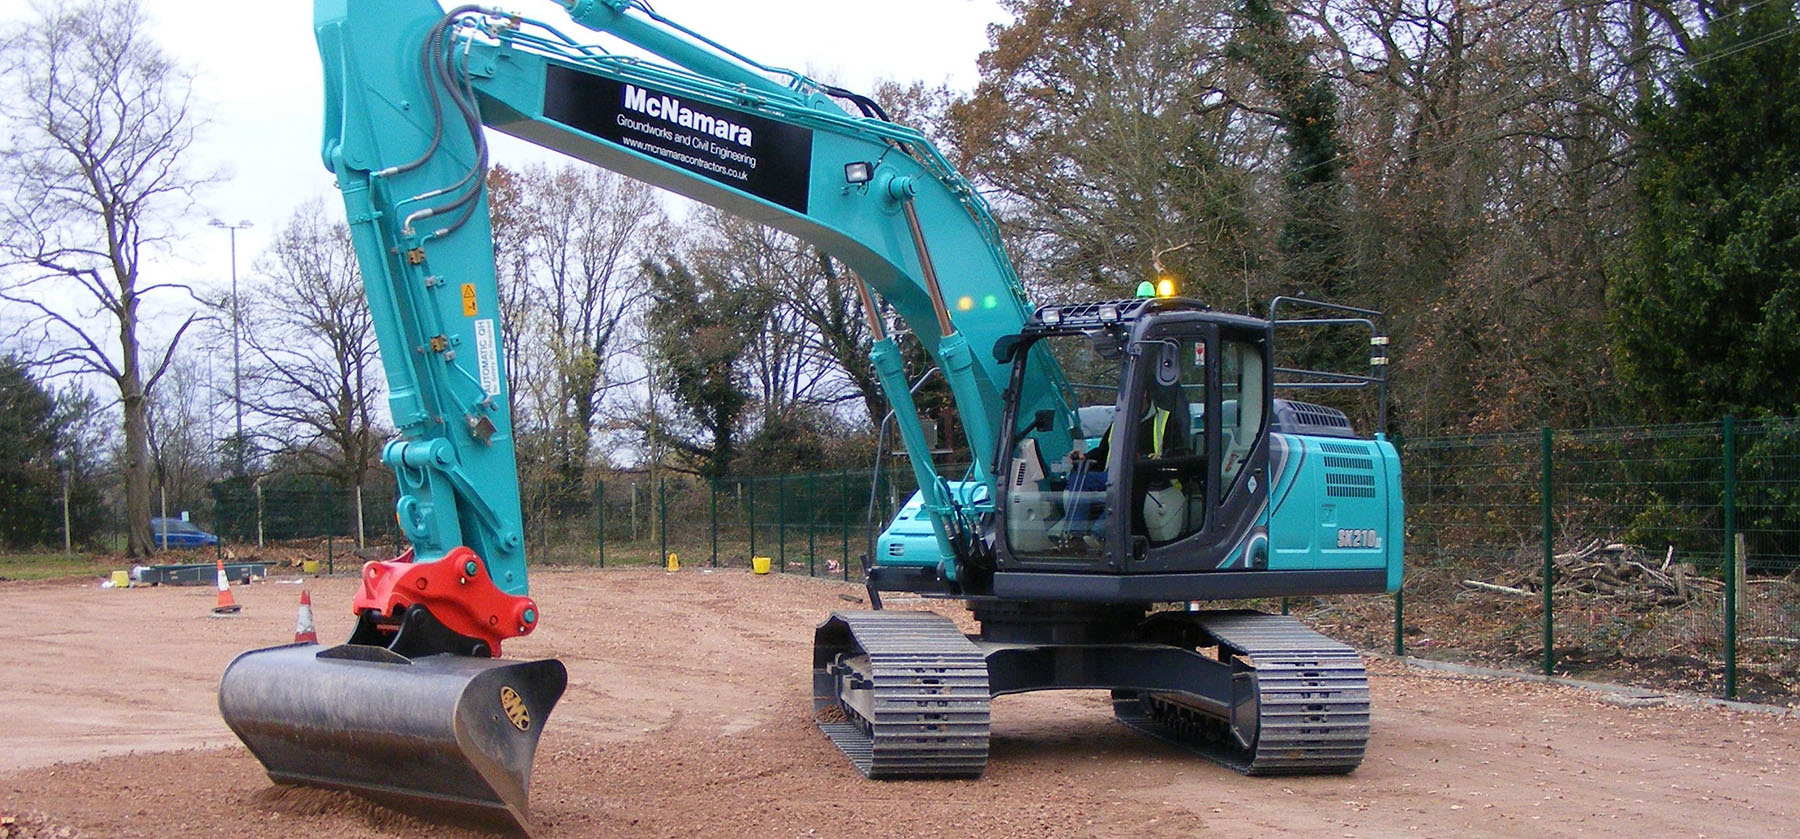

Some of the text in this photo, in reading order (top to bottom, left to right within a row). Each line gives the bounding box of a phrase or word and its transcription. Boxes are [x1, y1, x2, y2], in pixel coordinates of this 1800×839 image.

[616, 113, 757, 168] Groundworks and Civil Engineering
[623, 84, 752, 147] McNamara
[622, 135, 748, 181] www.mcnamaracontractors.co.uk
[480, 340, 492, 394] AUTOMATIC
